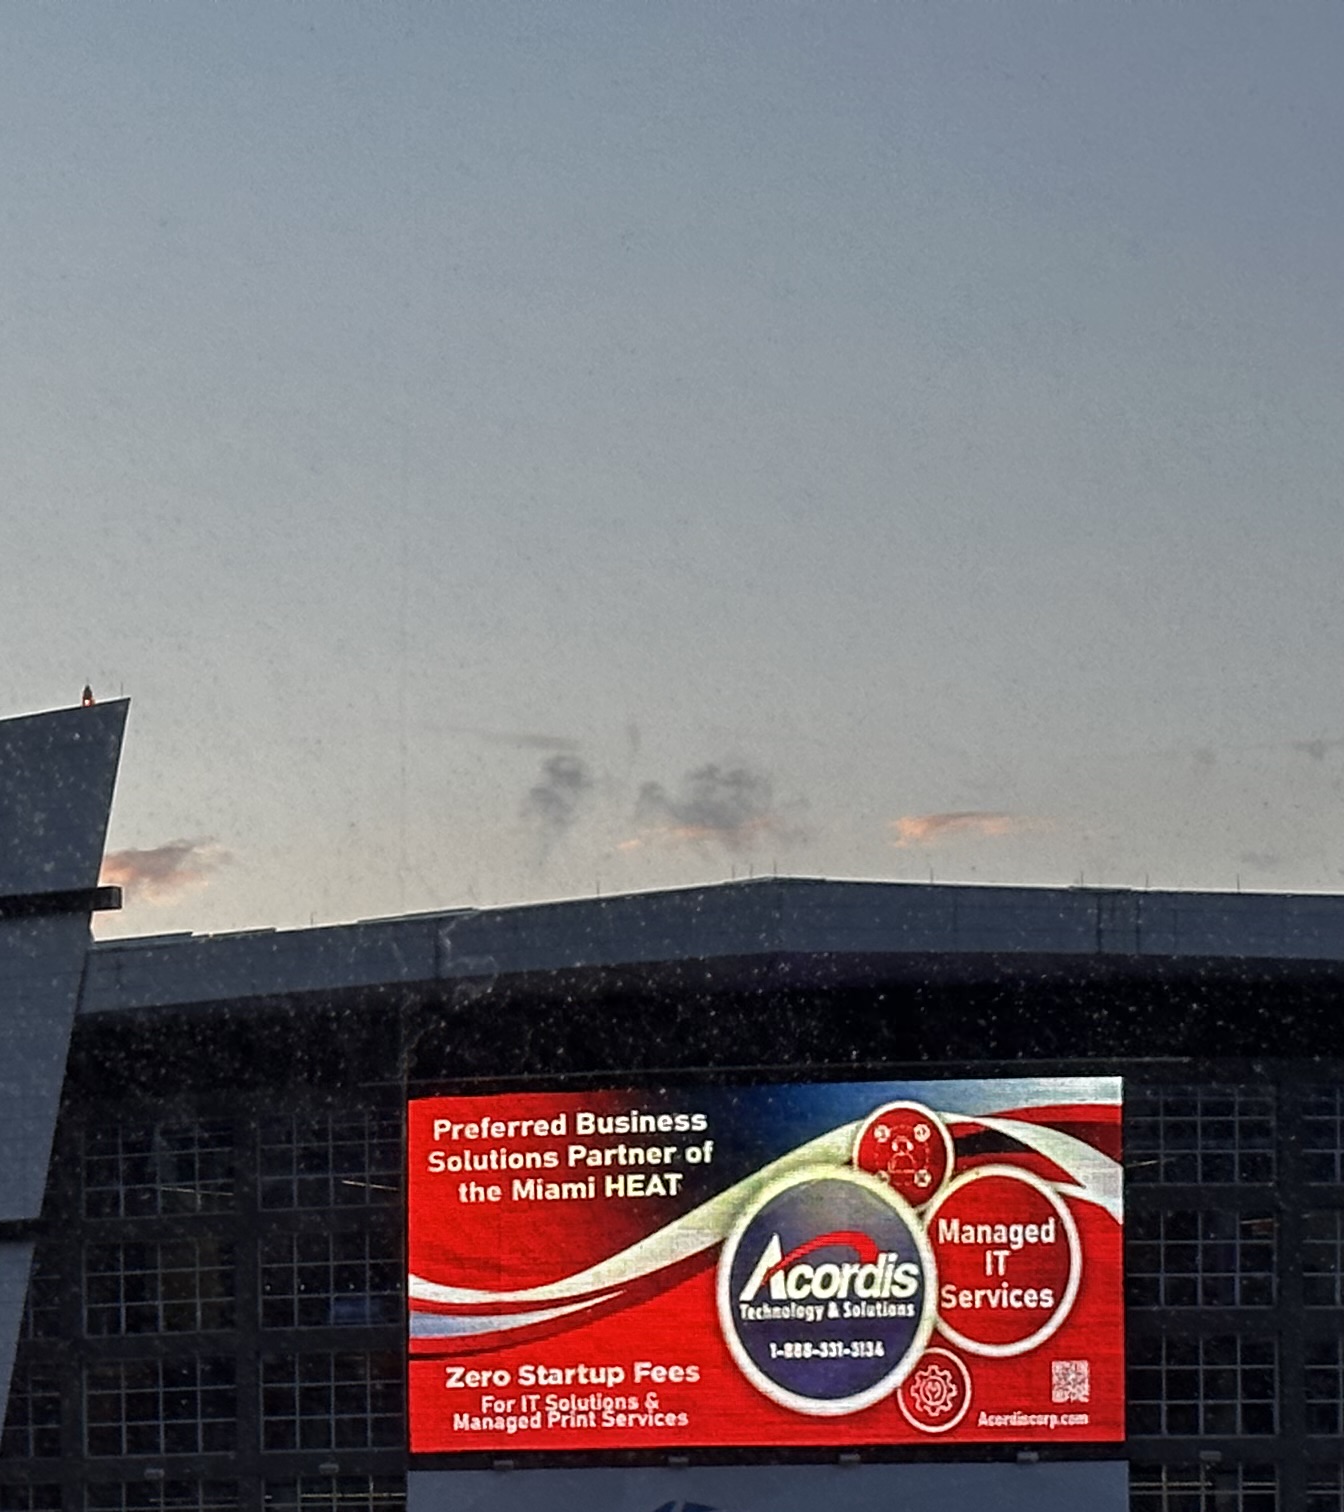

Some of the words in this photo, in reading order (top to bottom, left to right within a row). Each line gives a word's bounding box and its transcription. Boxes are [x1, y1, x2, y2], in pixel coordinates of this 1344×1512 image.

[433, 1114, 566, 1141] Preferred
[576, 1110, 708, 1136] Business
[427, 1148, 559, 1173] Solutions
[568, 1143, 678, 1168] Partner
[685, 1140, 714, 1164] of
[458, 1181, 502, 1203] the
[512, 1176, 596, 1202] Miami
[605, 1173, 684, 1198] HEAT
[938, 1216, 1056, 1250] Managed
[739, 1231, 920, 1300] Acordis
[985, 1250, 1011, 1276] IT
[940, 1281, 1055, 1309] Services
[739, 1302, 825, 1321] Technology
[827, 1302, 840, 1319] &
[843, 1301, 916, 1319] Solutions
[445, 1366, 511, 1388] Zero
[518, 1364, 625, 1388] Startup
[634, 1361, 701, 1383] Fees
[481, 1395, 516, 1413] For
[521, 1395, 540, 1412] IT
[545, 1392, 639, 1412] Solutions
[645, 1392, 660, 1410] &
[453, 1411, 542, 1433] Managed
[548, 1410, 596, 1429] Print
[602, 1408, 689, 1428] Services
